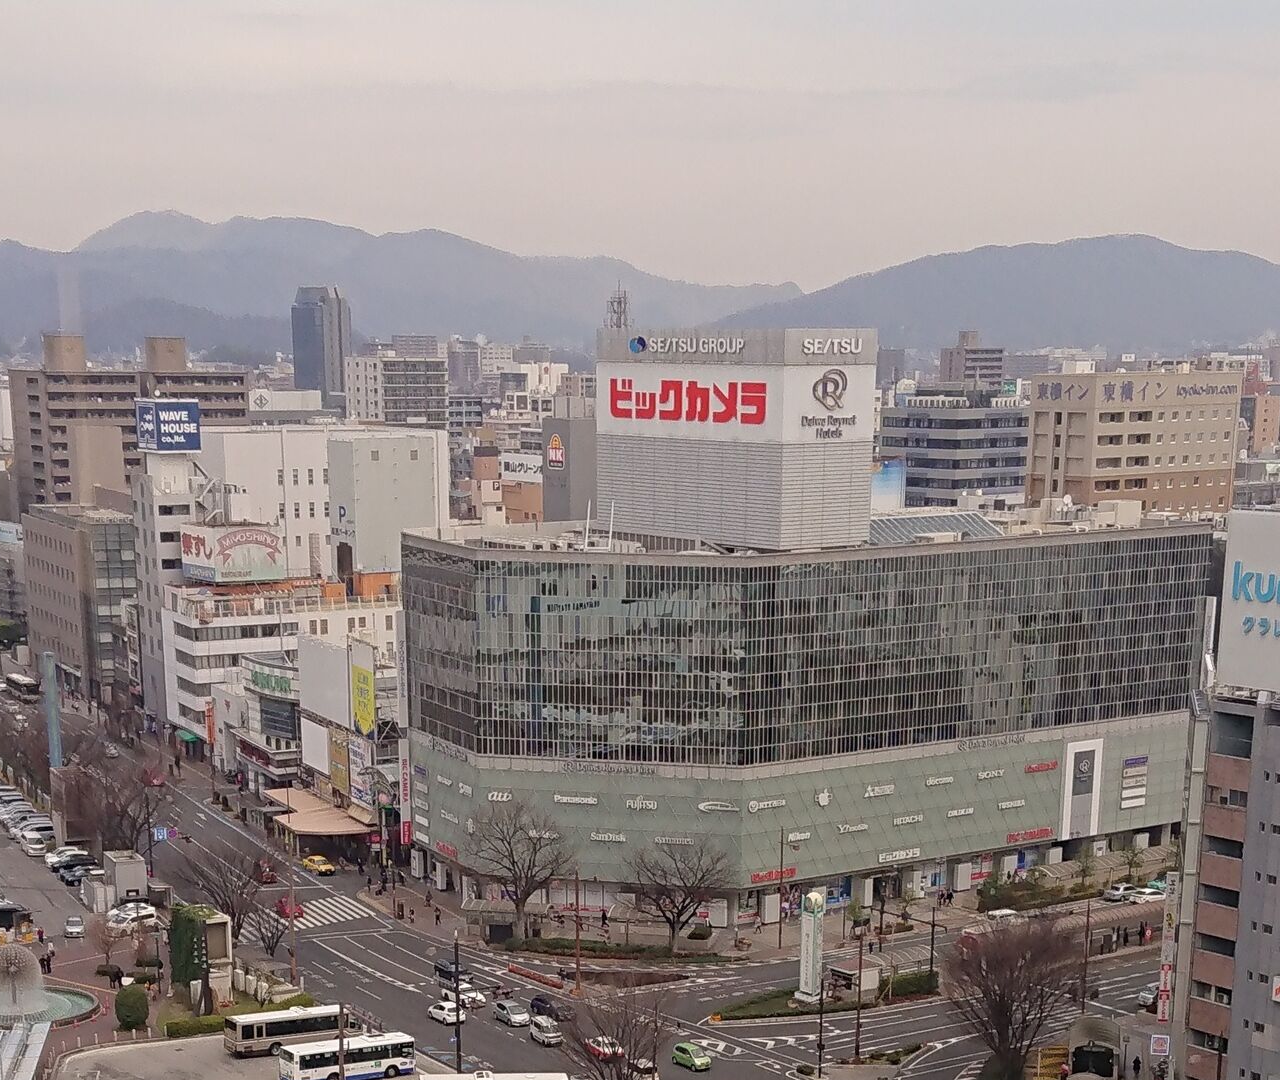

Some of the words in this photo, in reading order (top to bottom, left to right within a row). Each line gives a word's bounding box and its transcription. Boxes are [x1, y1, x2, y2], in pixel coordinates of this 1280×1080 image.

[700, 338, 745, 354] GROUP
[1036, 381, 1089, 401] 東横イン
[1102, 381, 1168, 402] 東横イン
[1176, 384, 1238, 398] toyoko-inn.com
[610, 378, 767, 425] ビックカメラ
[159, 411, 188, 421] WAVE
[801, 415, 826, 427] Daiwa
[161, 423, 197, 433] HOUSE
[338, 505, 347, 523] P
[978, 769, 1005, 780] SONY
[926, 776, 954, 786] docomo
[487, 789, 513, 802] au
[553, 794, 598, 805] Panasonic
[626, 795, 658, 811] FUJITSU
[998, 799, 1026, 810] TOSHIBA
[893, 814, 924, 826] HITACHI
[590, 831, 627, 842] SanDisk
[788, 832, 811, 842] Nikon
